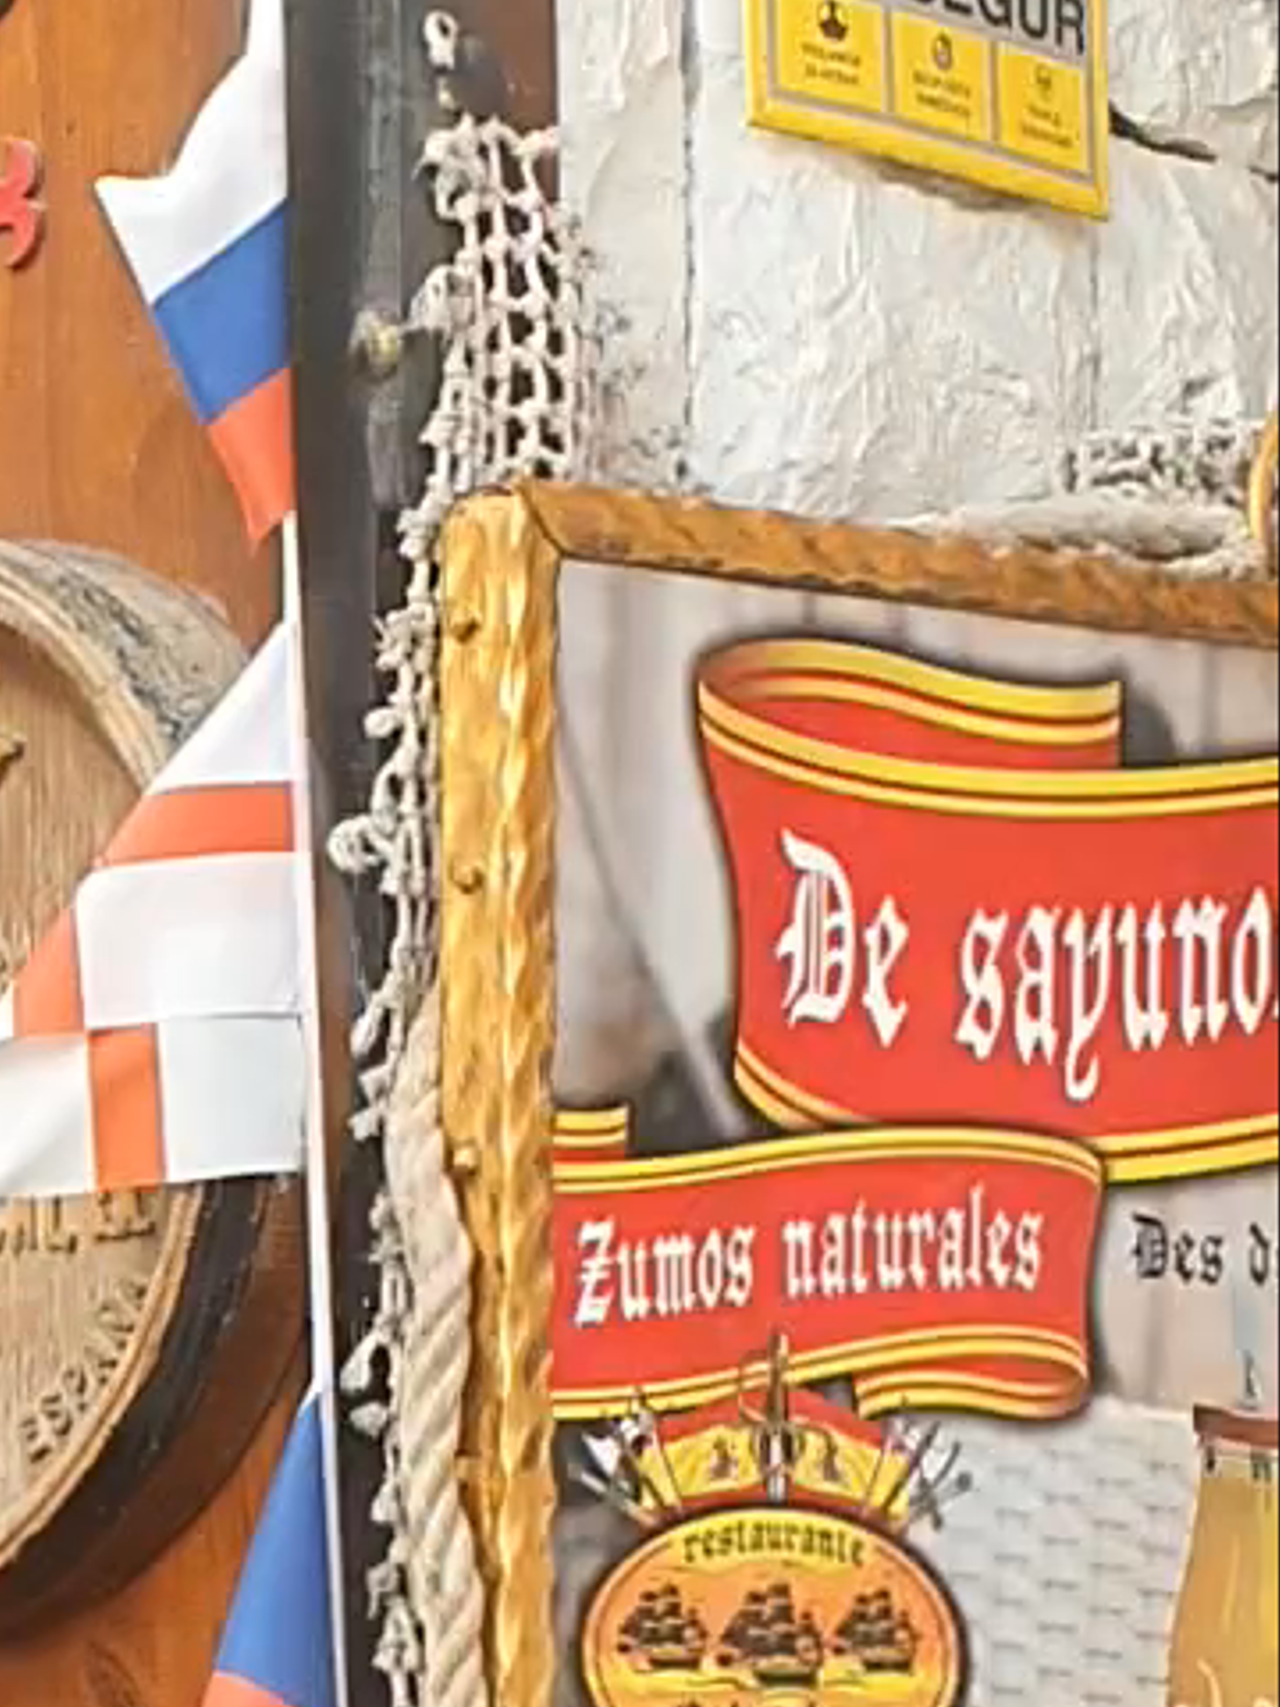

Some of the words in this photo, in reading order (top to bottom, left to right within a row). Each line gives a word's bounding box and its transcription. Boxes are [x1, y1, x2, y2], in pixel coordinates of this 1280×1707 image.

[776, 827, 910, 1049] De
[953, 885, 1278, 1103] sayuno
[574, 1215, 759, 1329] Zumos
[780, 1183, 1045, 1302] naturales
[1131, 1211, 1224, 1286] Des
[683, 1520, 866, 1568] restaurante
